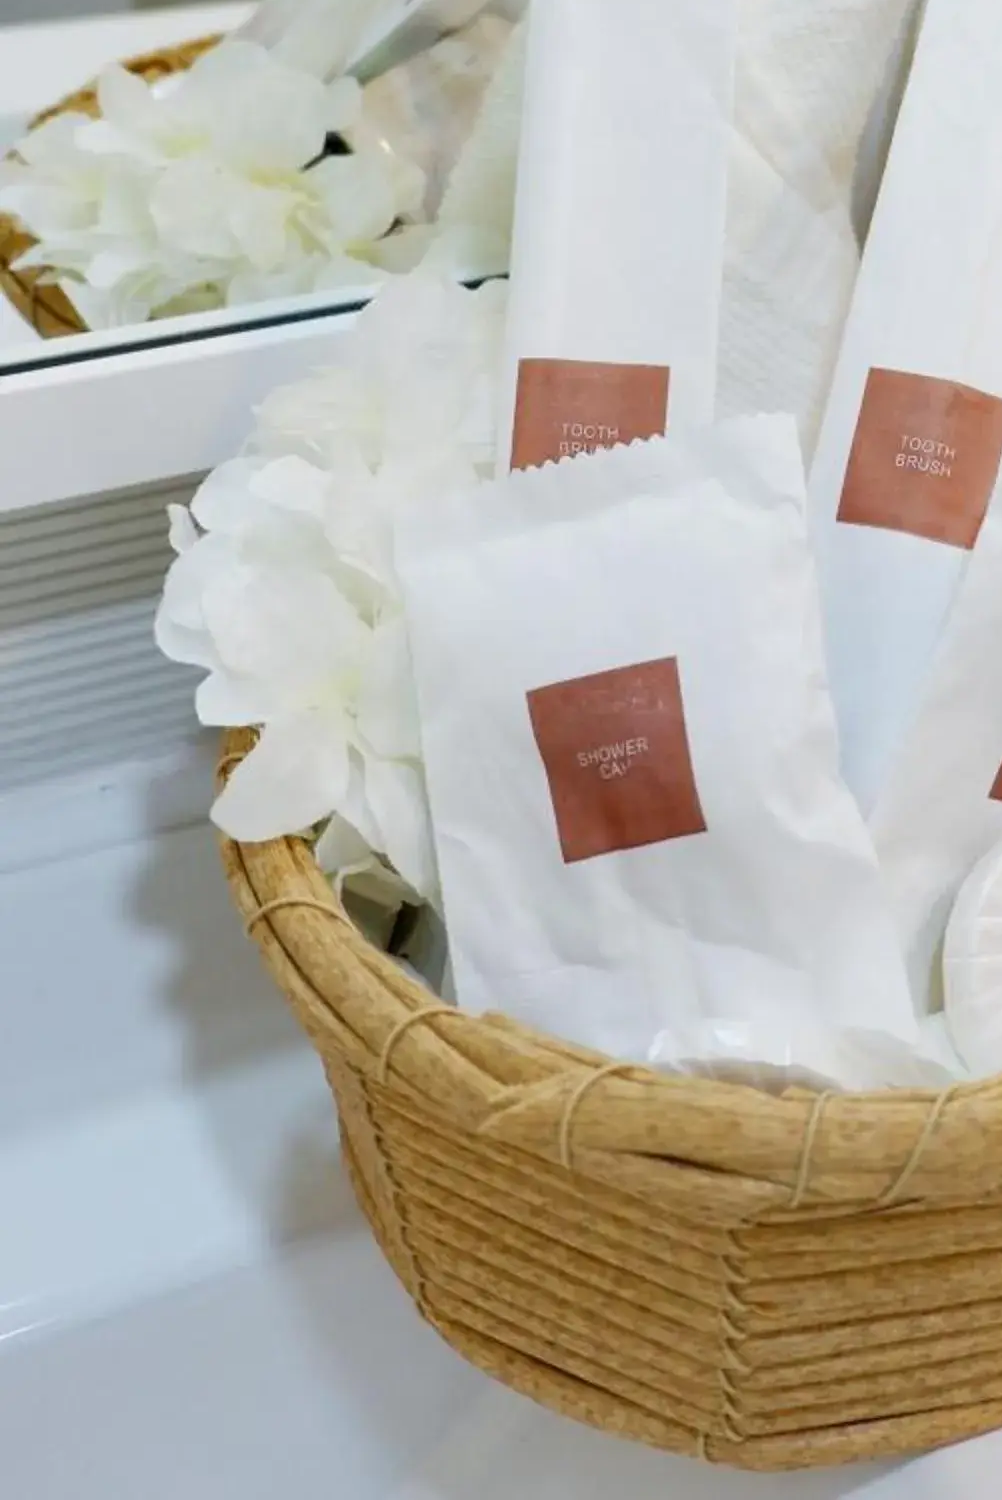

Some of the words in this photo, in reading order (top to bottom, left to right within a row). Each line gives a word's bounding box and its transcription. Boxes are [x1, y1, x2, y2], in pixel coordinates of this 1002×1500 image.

[561, 423, 619, 440] TOOTH
[900, 434, 957, 460] TOOTH
[895, 453, 952, 477] BRUSH
[577, 736, 649, 767] SHOWER
